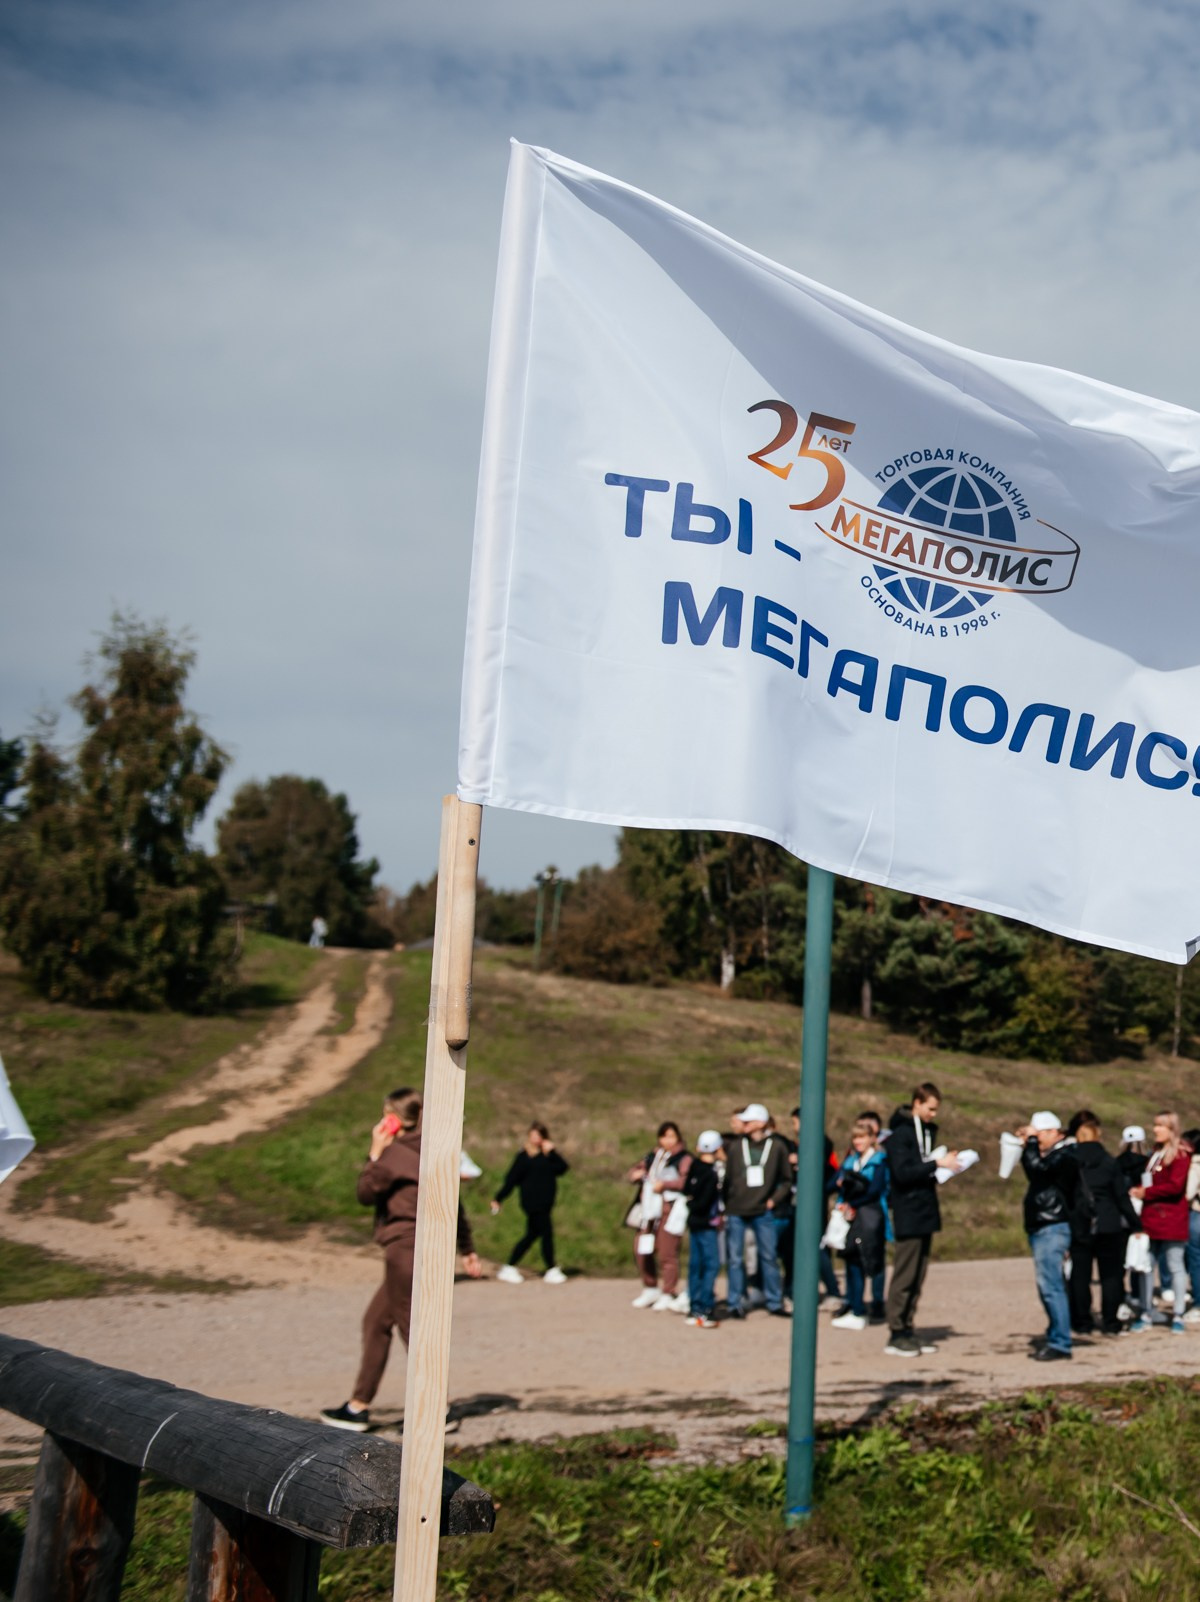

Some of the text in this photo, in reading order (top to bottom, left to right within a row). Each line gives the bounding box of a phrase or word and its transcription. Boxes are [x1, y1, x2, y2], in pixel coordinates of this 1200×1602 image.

[746, 398, 857, 512] 25
[817, 434, 852, 454] лет
[604, 472, 753, 556] ТЫ
[875, 448, 1032, 521] ТОРГОВАЯ КОМПАНИЯ
[830, 504, 1053, 587] МЕГАПОЛИС
[860, 575, 936, 638] ОСНОВАНА
[939, 624, 949, 638] В
[953, 614, 988, 637] 1998
